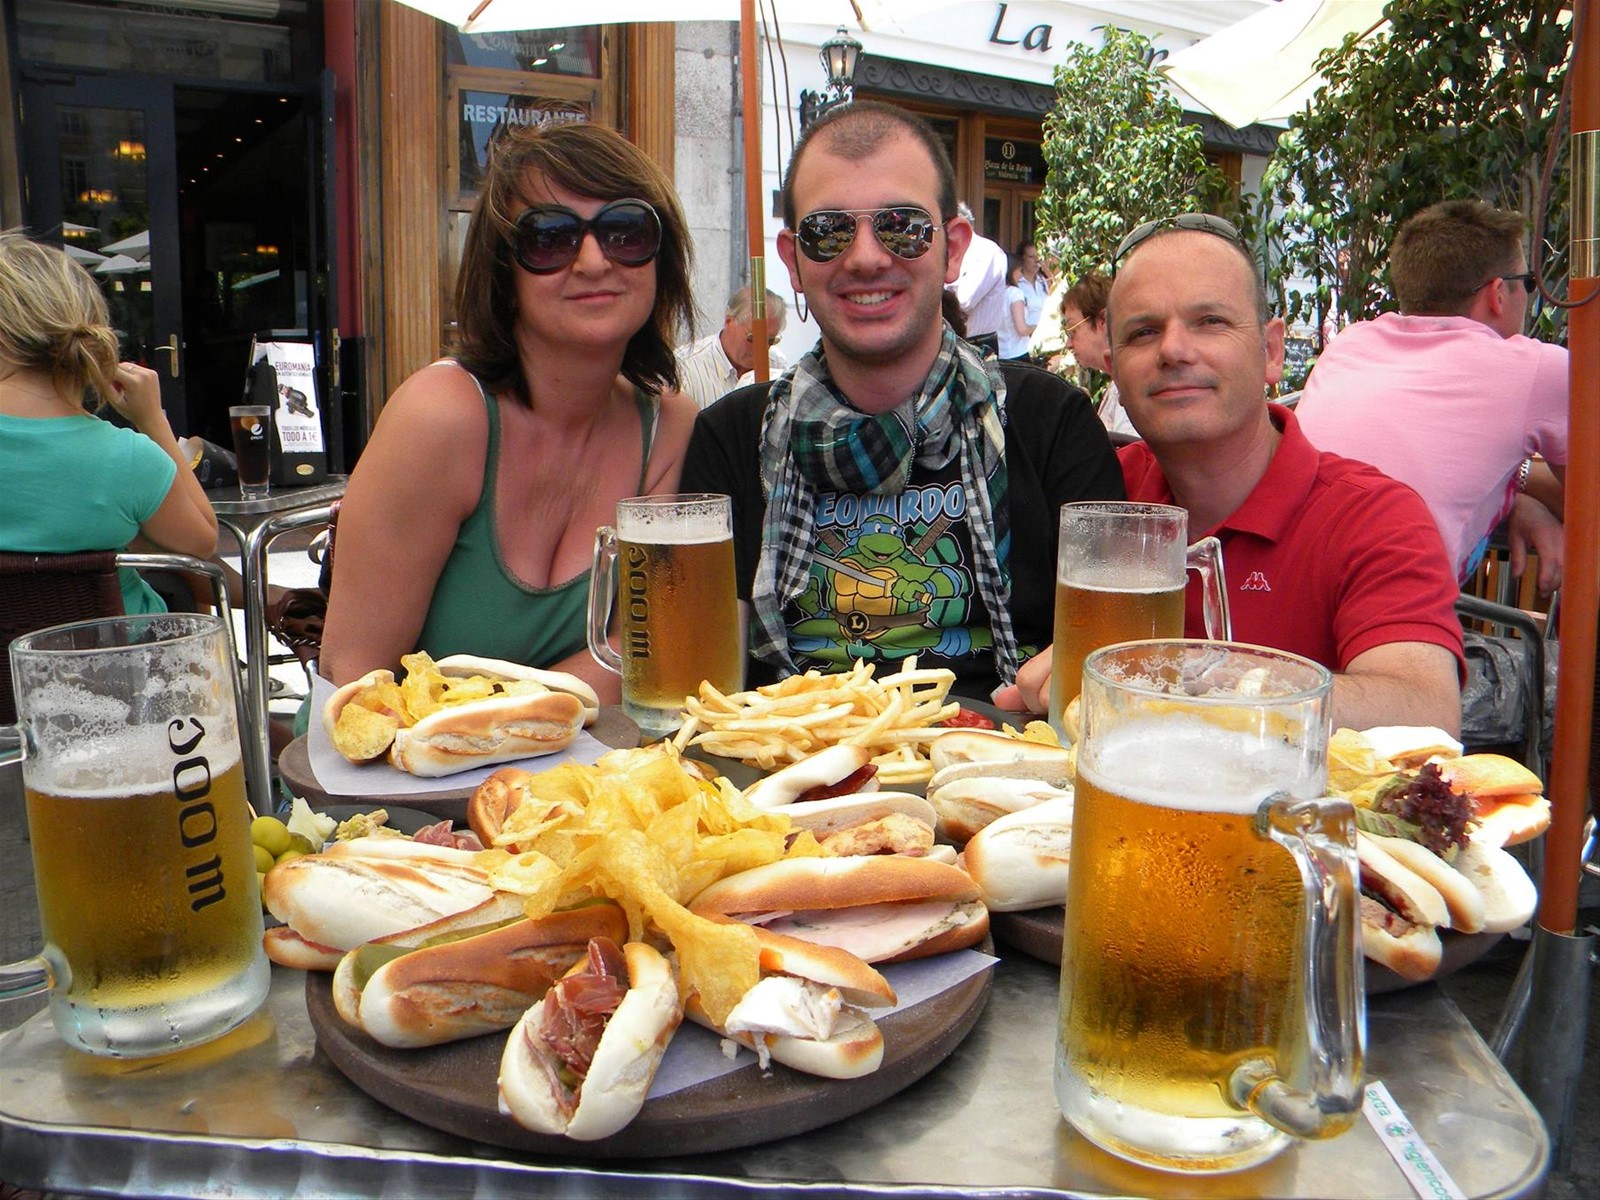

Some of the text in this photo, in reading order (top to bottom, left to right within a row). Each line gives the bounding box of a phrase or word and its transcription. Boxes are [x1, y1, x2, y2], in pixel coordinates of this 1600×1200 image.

[989, 2, 1053, 53] La
[1004, 145, 1013, 156] 11
[282, 431, 318, 442] TODO A 1€
[816, 484, 966, 526] EONARDO
[851, 615, 865, 630] L
[1366, 1089, 1391, 1117] extra
